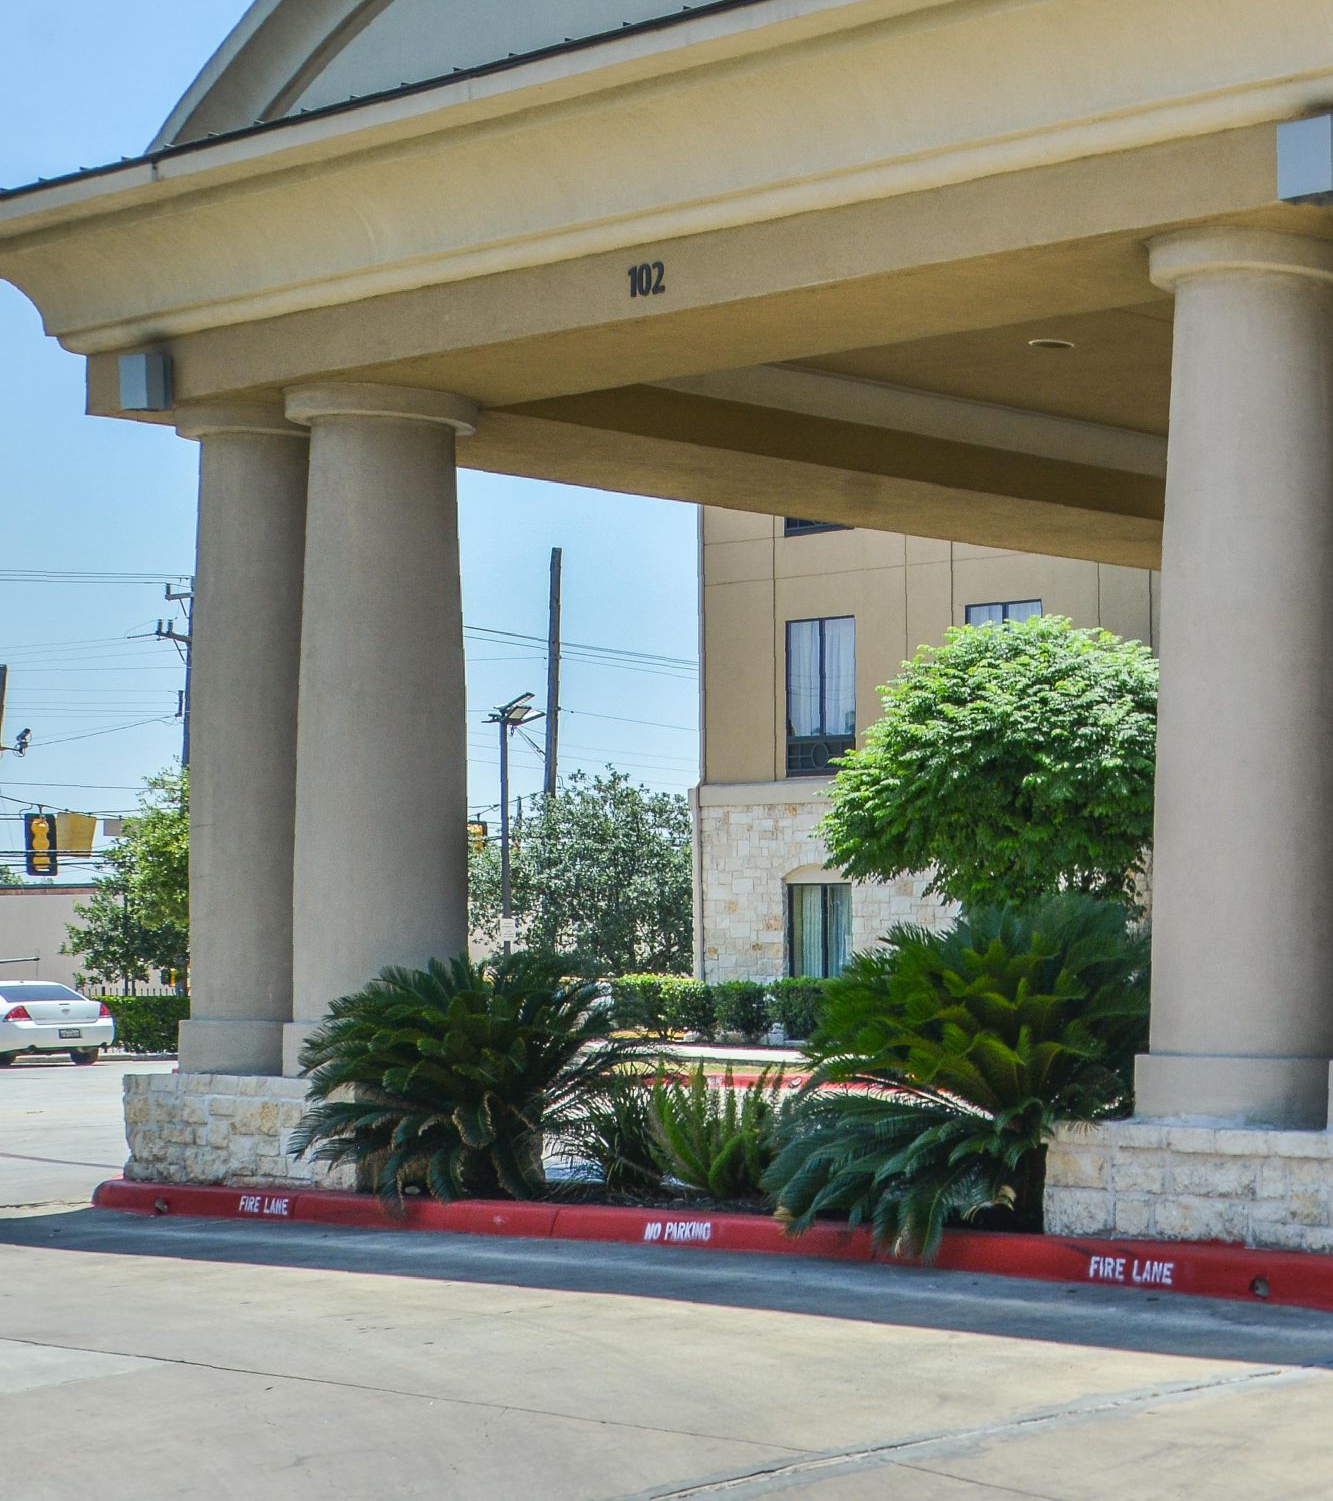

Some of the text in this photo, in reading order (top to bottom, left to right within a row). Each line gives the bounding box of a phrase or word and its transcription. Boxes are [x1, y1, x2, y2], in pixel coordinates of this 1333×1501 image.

[628, 261, 665, 297] 102
[239, 1196, 289, 1215] FIRE LANE
[644, 1221, 711, 1240] NO PARKING
[1089, 1256, 1174, 1284] FIRE LANE
